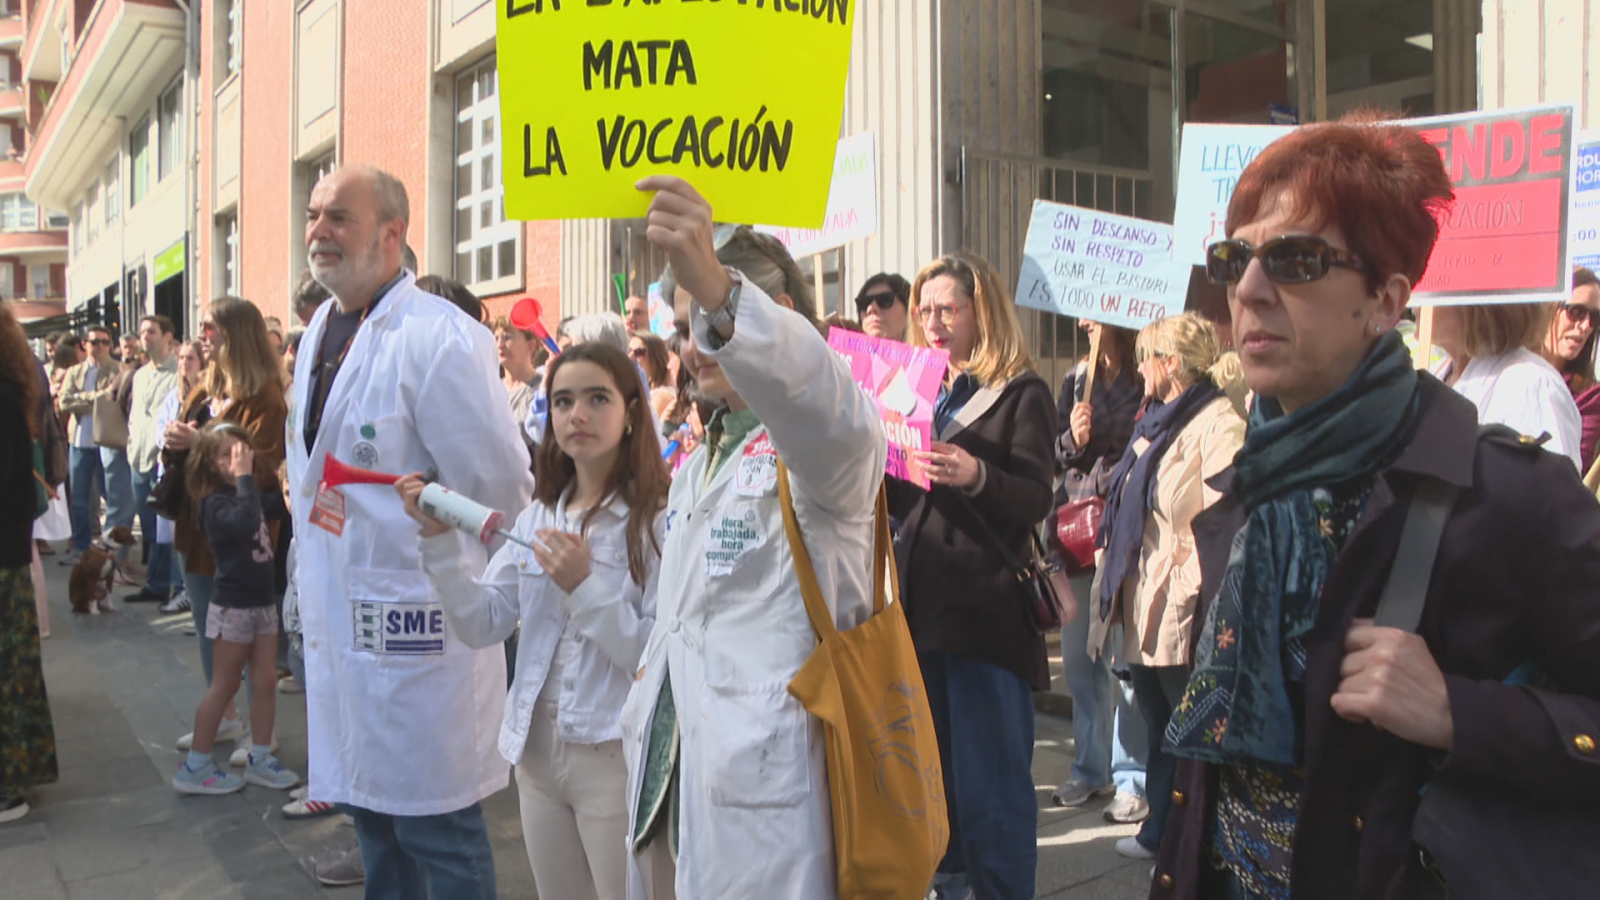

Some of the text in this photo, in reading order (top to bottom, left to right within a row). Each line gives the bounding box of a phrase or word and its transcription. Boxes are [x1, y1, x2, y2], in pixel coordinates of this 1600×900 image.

[583, 39, 697, 90] MATA
[523, 105, 793, 177] LA VOCACIÓN
[1053, 211, 1080, 231] SIN
[1092, 218, 1157, 246] DESCANSO
[1051, 235, 1144, 267] SIN RESPETO
[1054, 258, 1085, 280] USAR
[1092, 266, 1108, 284] EL
[1061, 284, 1095, 310] TODO
[1100, 292, 1122, 313] UN
[1126, 297, 1166, 320] RETO
[710, 527, 760, 542] trabajada,
[721, 517, 744, 528] Hora
[721, 540, 744, 550] hora
[386, 609, 443, 635] SME
